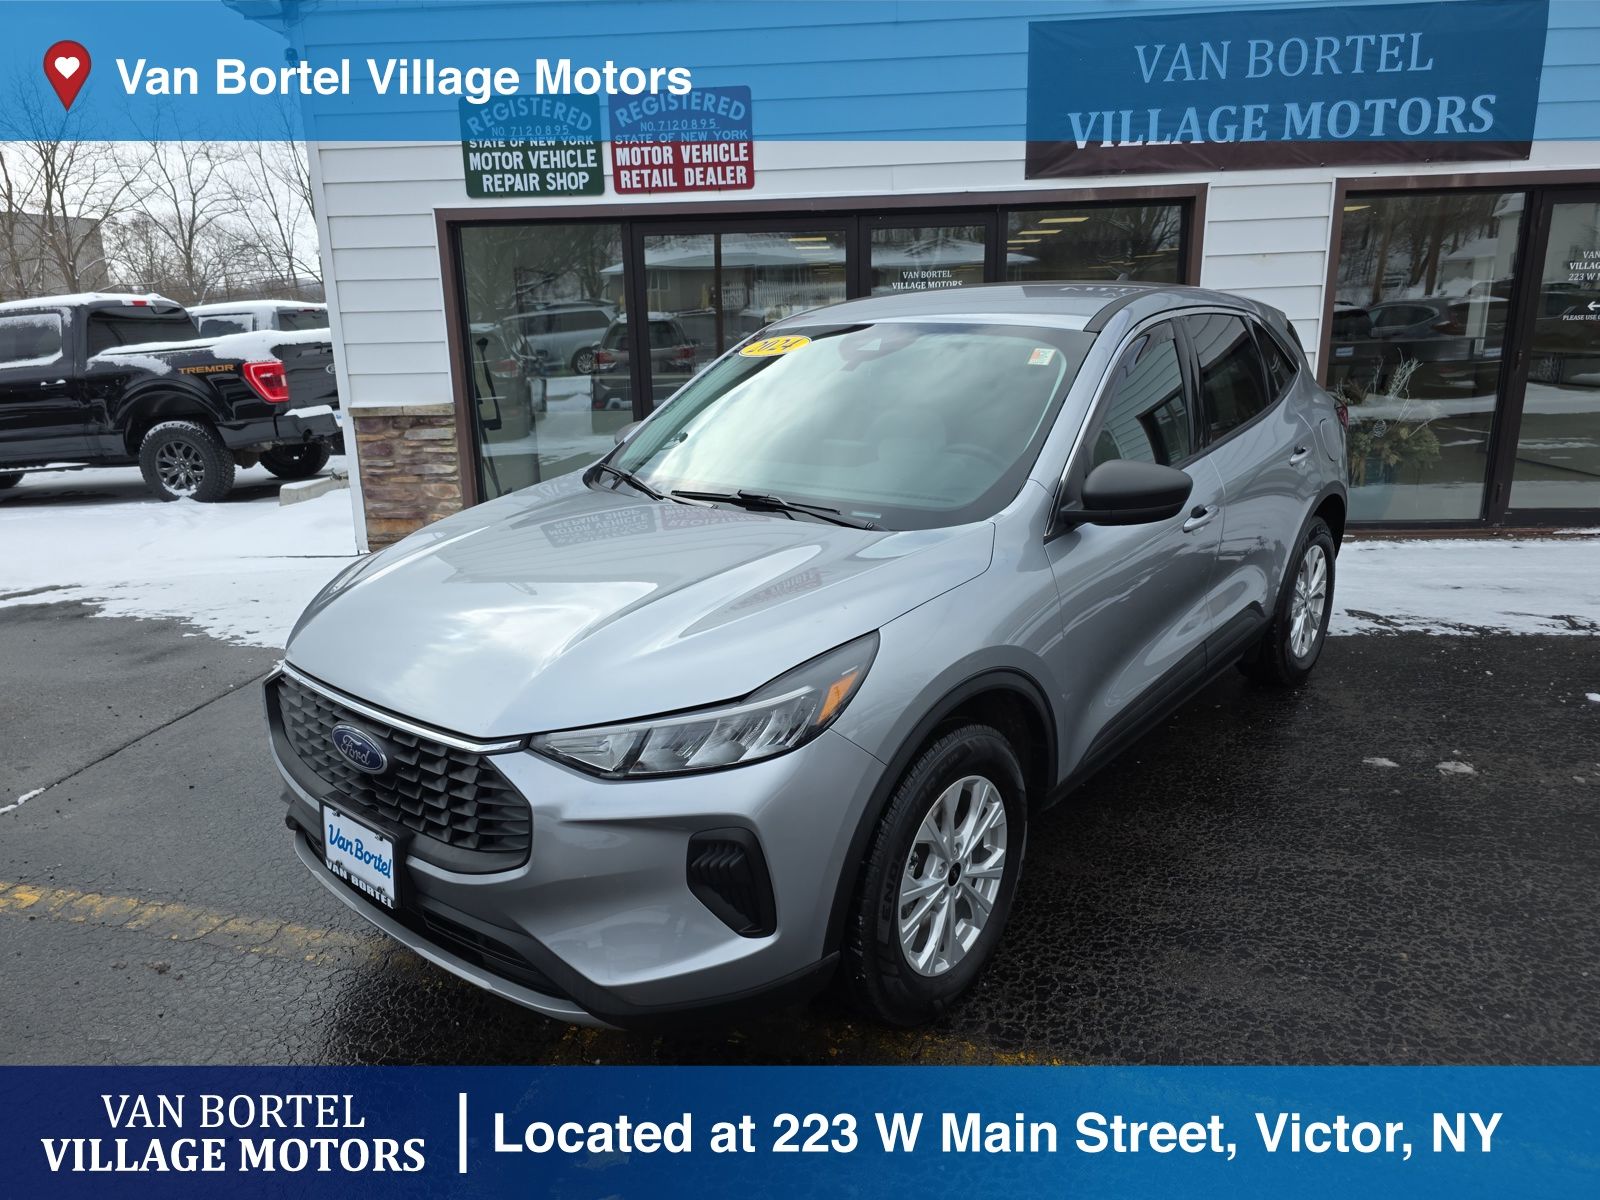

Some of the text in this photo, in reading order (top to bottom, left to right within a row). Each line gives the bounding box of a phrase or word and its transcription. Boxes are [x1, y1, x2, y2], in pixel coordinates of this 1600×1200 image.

[1134, 32, 1434, 84] VAN BORTEL
[467, 97, 592, 135] REGISTERED
[615, 91, 746, 128] REGISTERED
[511, 125, 570, 136] 7120895
[659, 118, 717, 131] 7120895
[1067, 94, 1497, 150] VILLAGE MOTORS
[469, 135, 594, 149] STATE OF NEW YORK
[614, 129, 748, 145] STATE OF NEW YORK
[469, 149, 597, 171] MOTOR VEHICLE
[615, 143, 749, 167] MOTOR VEHICLE
[482, 172, 590, 192] REPAIR SHOP
[620, 166, 748, 189] RETAIL DEALER
[1583, 250, 1600, 259] VAN
[892, 280, 963, 290] VILLAGE MOTORS
[902, 270, 953, 279] VAN BORTEL
[1568, 272, 1584, 281] 223
[1586, 272, 1596, 281] W
[177, 364, 235, 375] TREMOR
[341, 735, 371, 765] Ford
[328, 824, 392, 879] Van Bortel
[325, 859, 394, 910] VAN BORTEL
